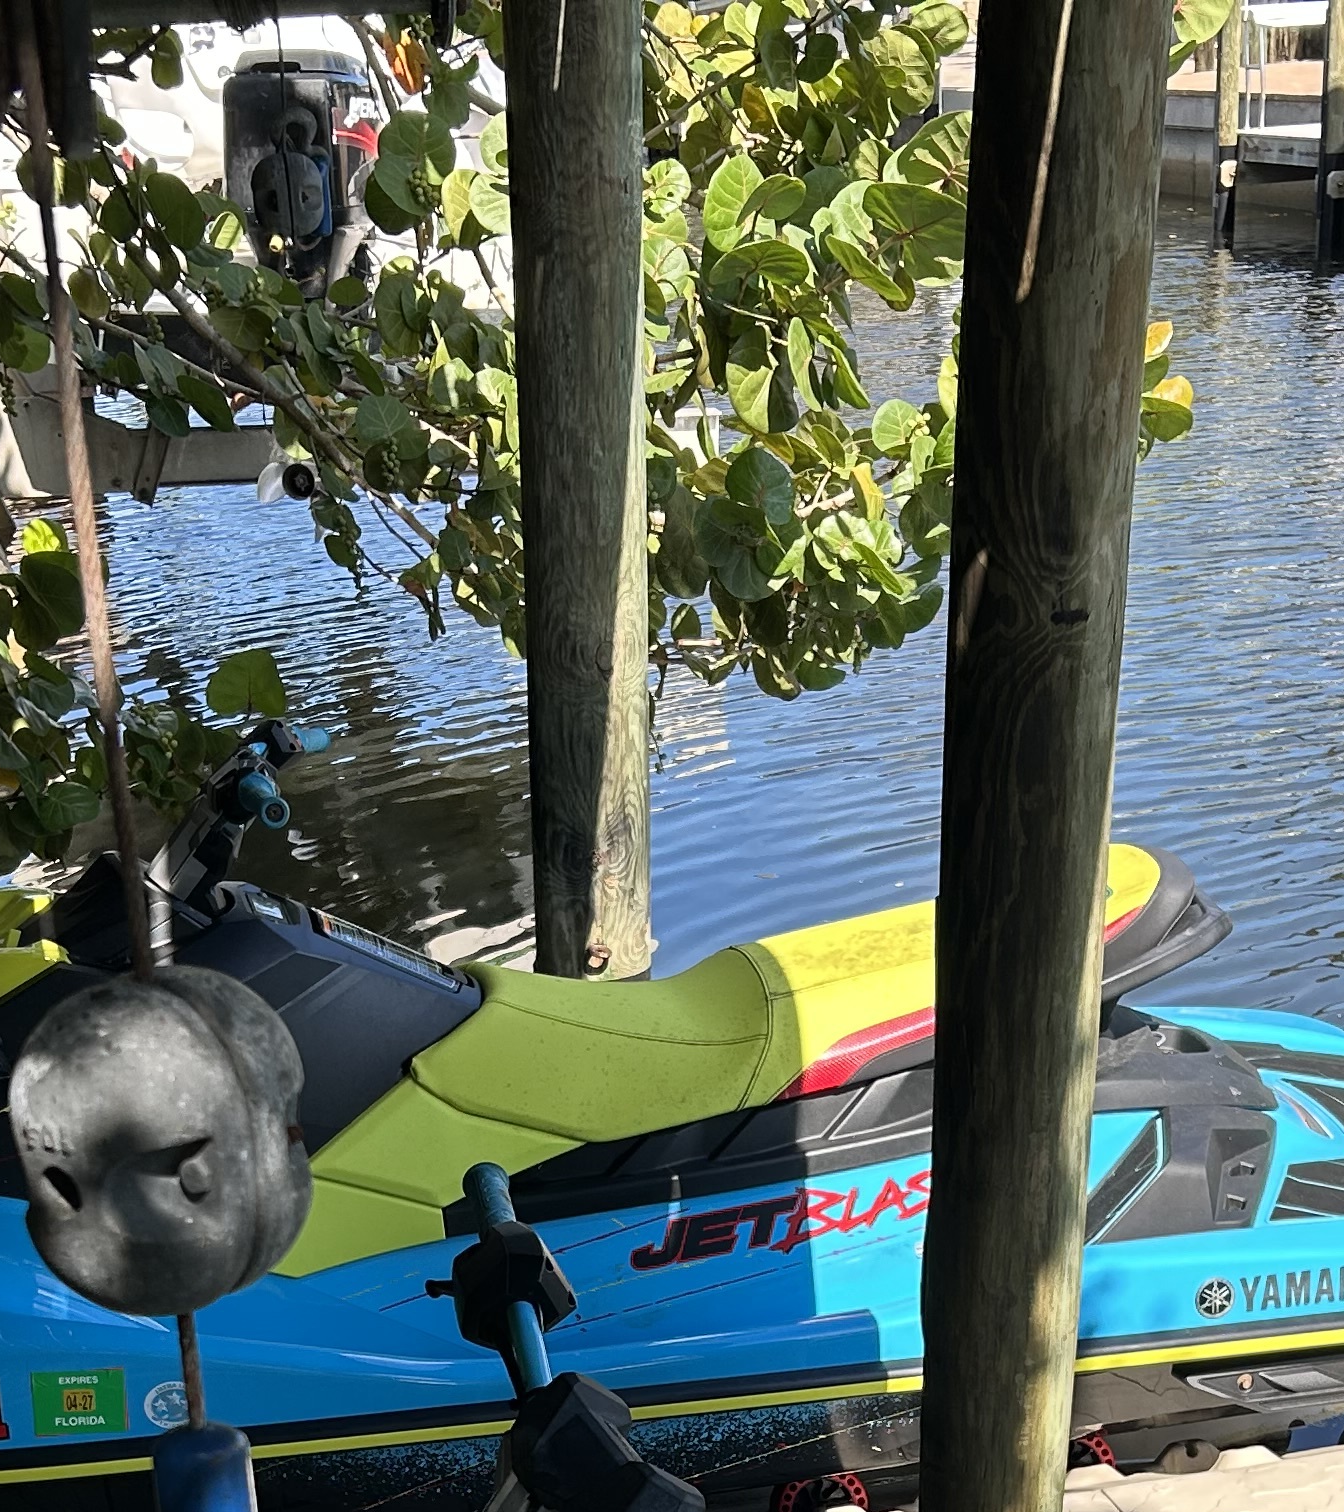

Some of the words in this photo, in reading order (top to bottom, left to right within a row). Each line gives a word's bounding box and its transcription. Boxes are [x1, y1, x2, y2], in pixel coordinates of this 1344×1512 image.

[58, 1375, 99, 1386] EXPIRES
[65, 1394, 94, 1411] 04-27
[54, 1415, 106, 1427] FLORIDA
